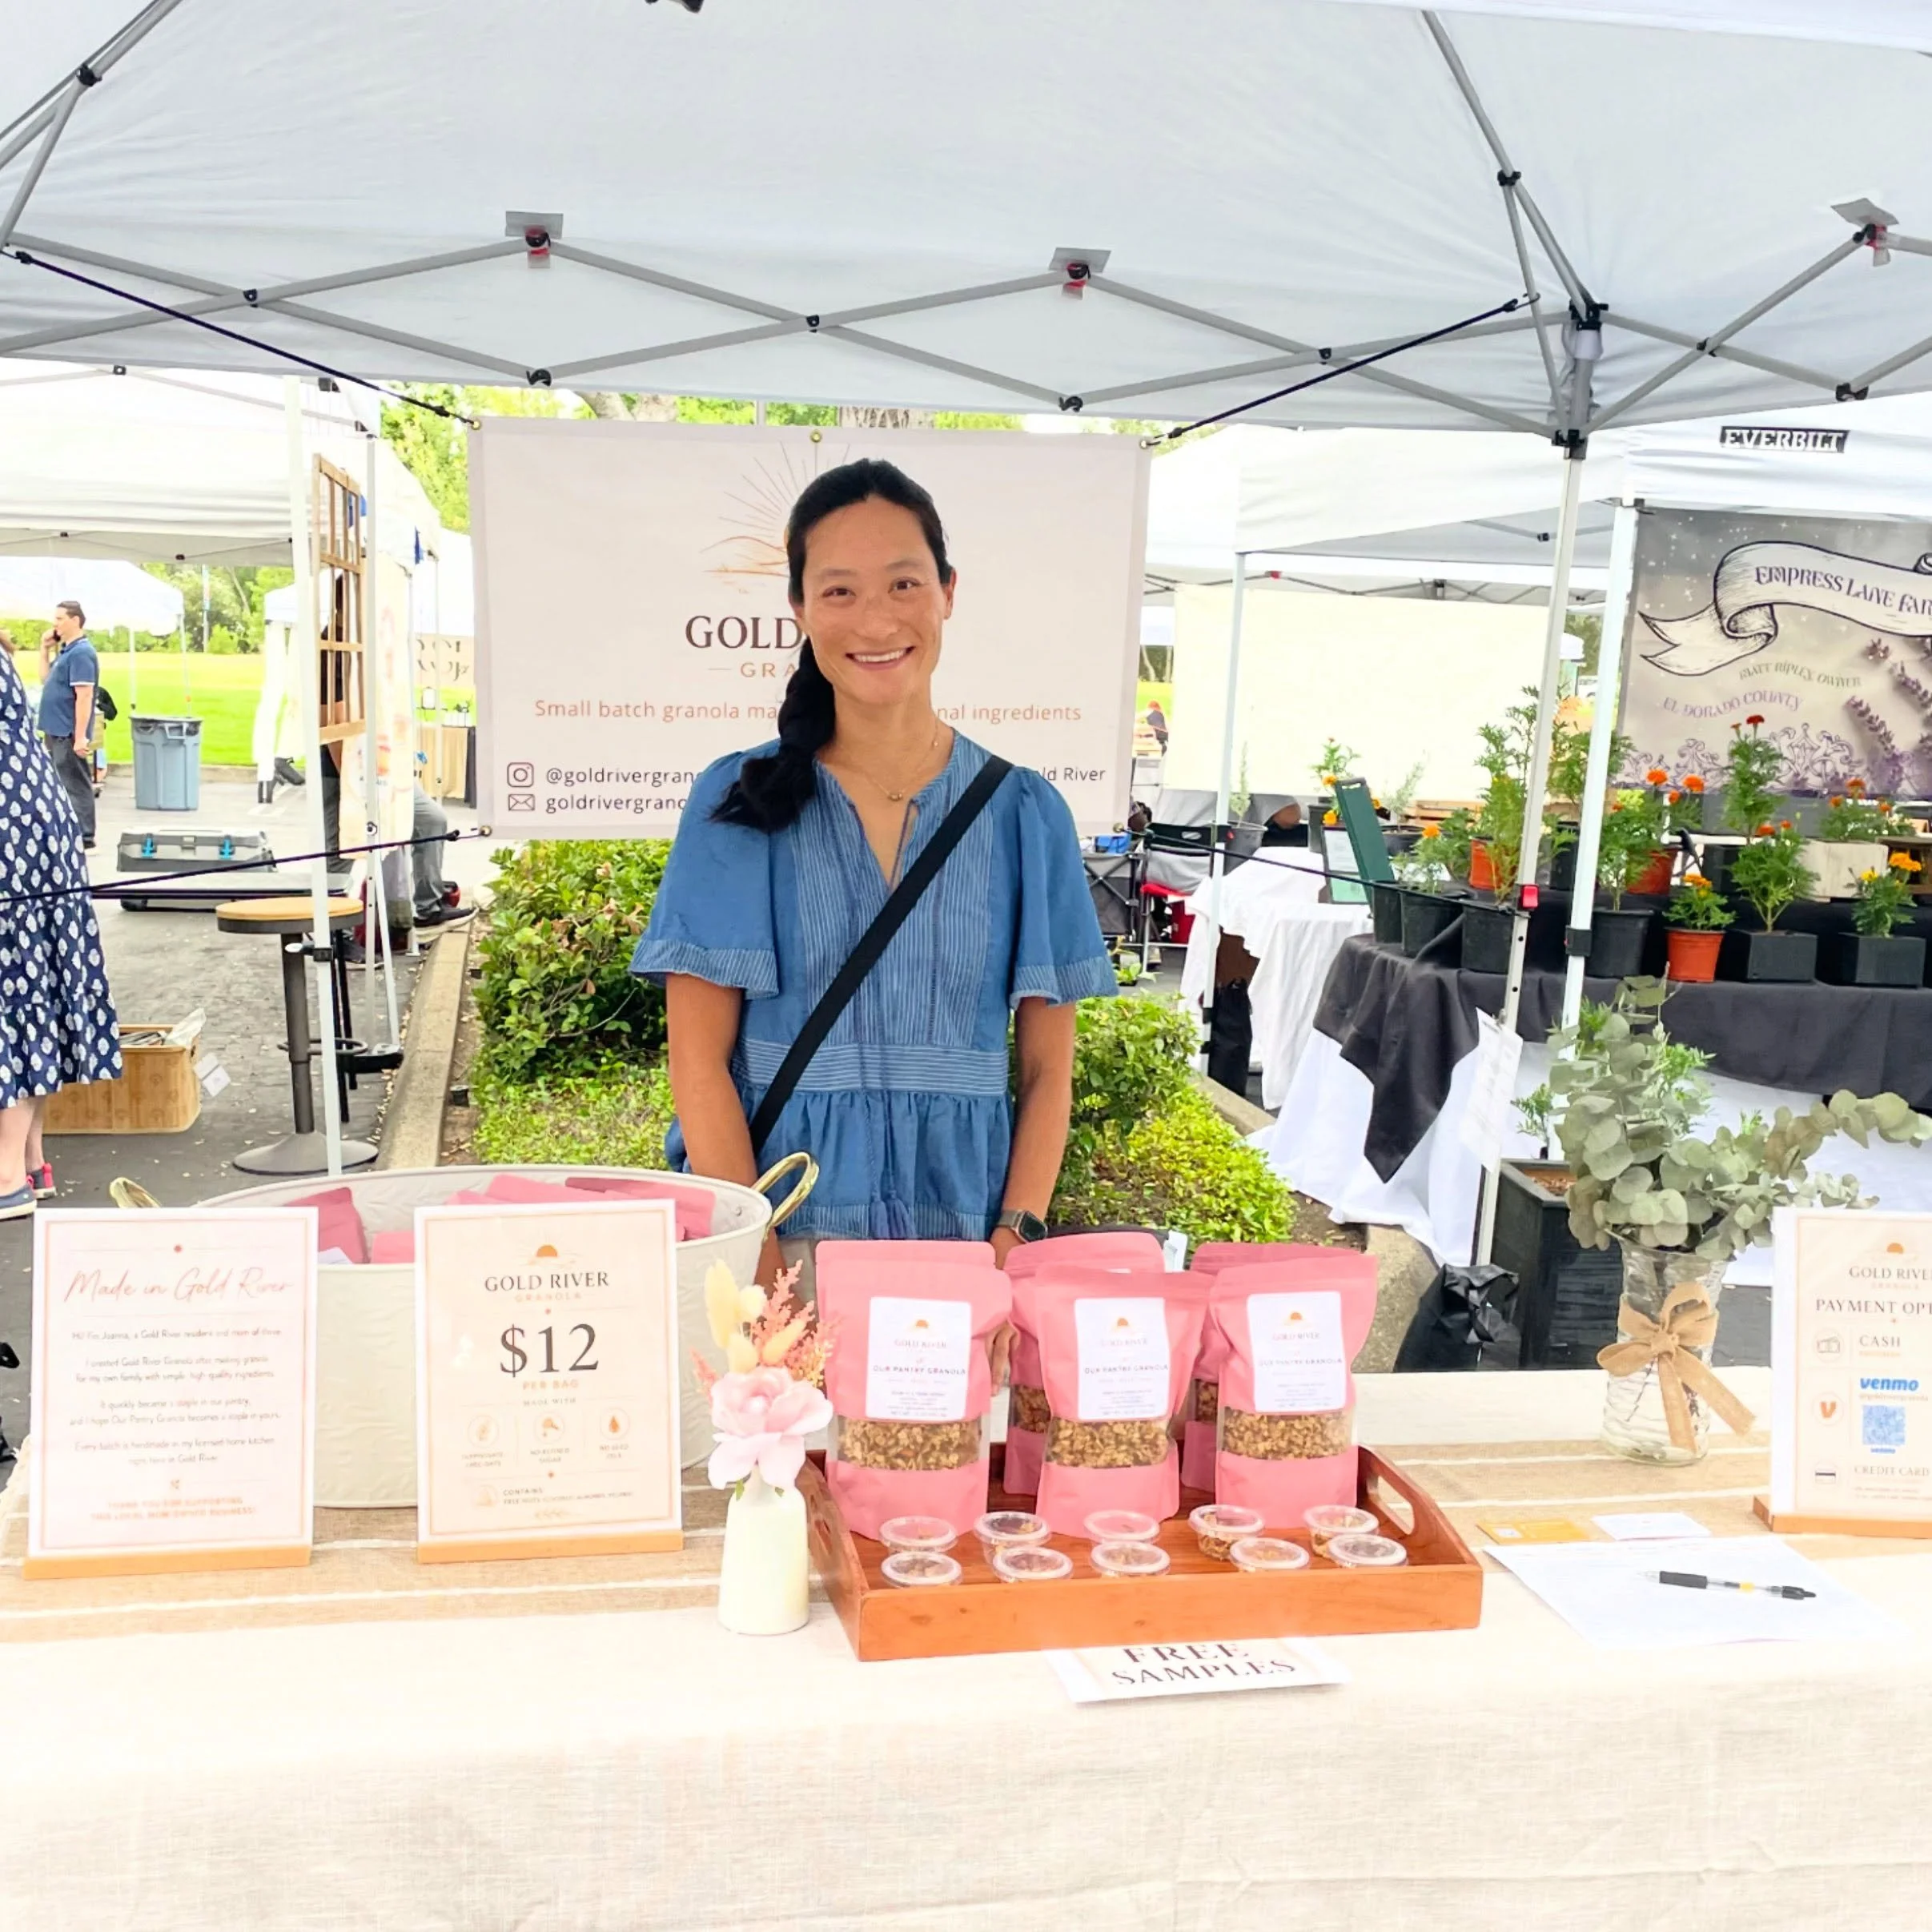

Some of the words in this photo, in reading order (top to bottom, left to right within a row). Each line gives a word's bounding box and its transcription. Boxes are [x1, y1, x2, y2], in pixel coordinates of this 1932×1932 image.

[1721, 428, 1846, 452] EVERBILT
[1755, 565, 1844, 592] EMPRESS
[1846, 577, 1896, 608] LANE
[685, 616, 803, 649] GOLD
[534, 699, 592, 717] Small
[598, 701, 656, 718] batch
[662, 702, 740, 722] granola
[973, 705, 1081, 725] ingredients
[1662, 697, 1678, 713] EL
[1682, 697, 1741, 718] DORADO
[1742, 689, 1804, 712] COUNTY
[1062, 766, 1107, 781] River
[484, 1275, 542, 1291] GOLD
[550, 1271, 609, 1289] RIVER
[1849, 1265, 1892, 1279] GOLD
[1896, 1267, 1932, 1280] RIVE
[64, 1268, 136, 1303] Made
[143, 1279, 167, 1295] in
[174, 1267, 233, 1303] Gold
[237, 1266, 294, 1299] River
[514, 1291, 582, 1303] GRANOLA
[1815, 1298, 1898, 1314] PAYMENT
[500, 1323, 599, 1379] $12
[1858, 1334, 1901, 1348] CASH
[893, 1365, 924, 1373] PANTRY
[927, 1367, 966, 1376] GRANOLA
[523, 1380, 547, 1391] PER
[552, 1378, 580, 1389] BAG
[1859, 1377, 1920, 1392] venmo
[1854, 1465, 1896, 1476] CREDIT
[1898, 1466, 1930, 1477] CARD
[1122, 1642, 1249, 1664] FREE
[1111, 1659, 1297, 1685] SAMPLES
